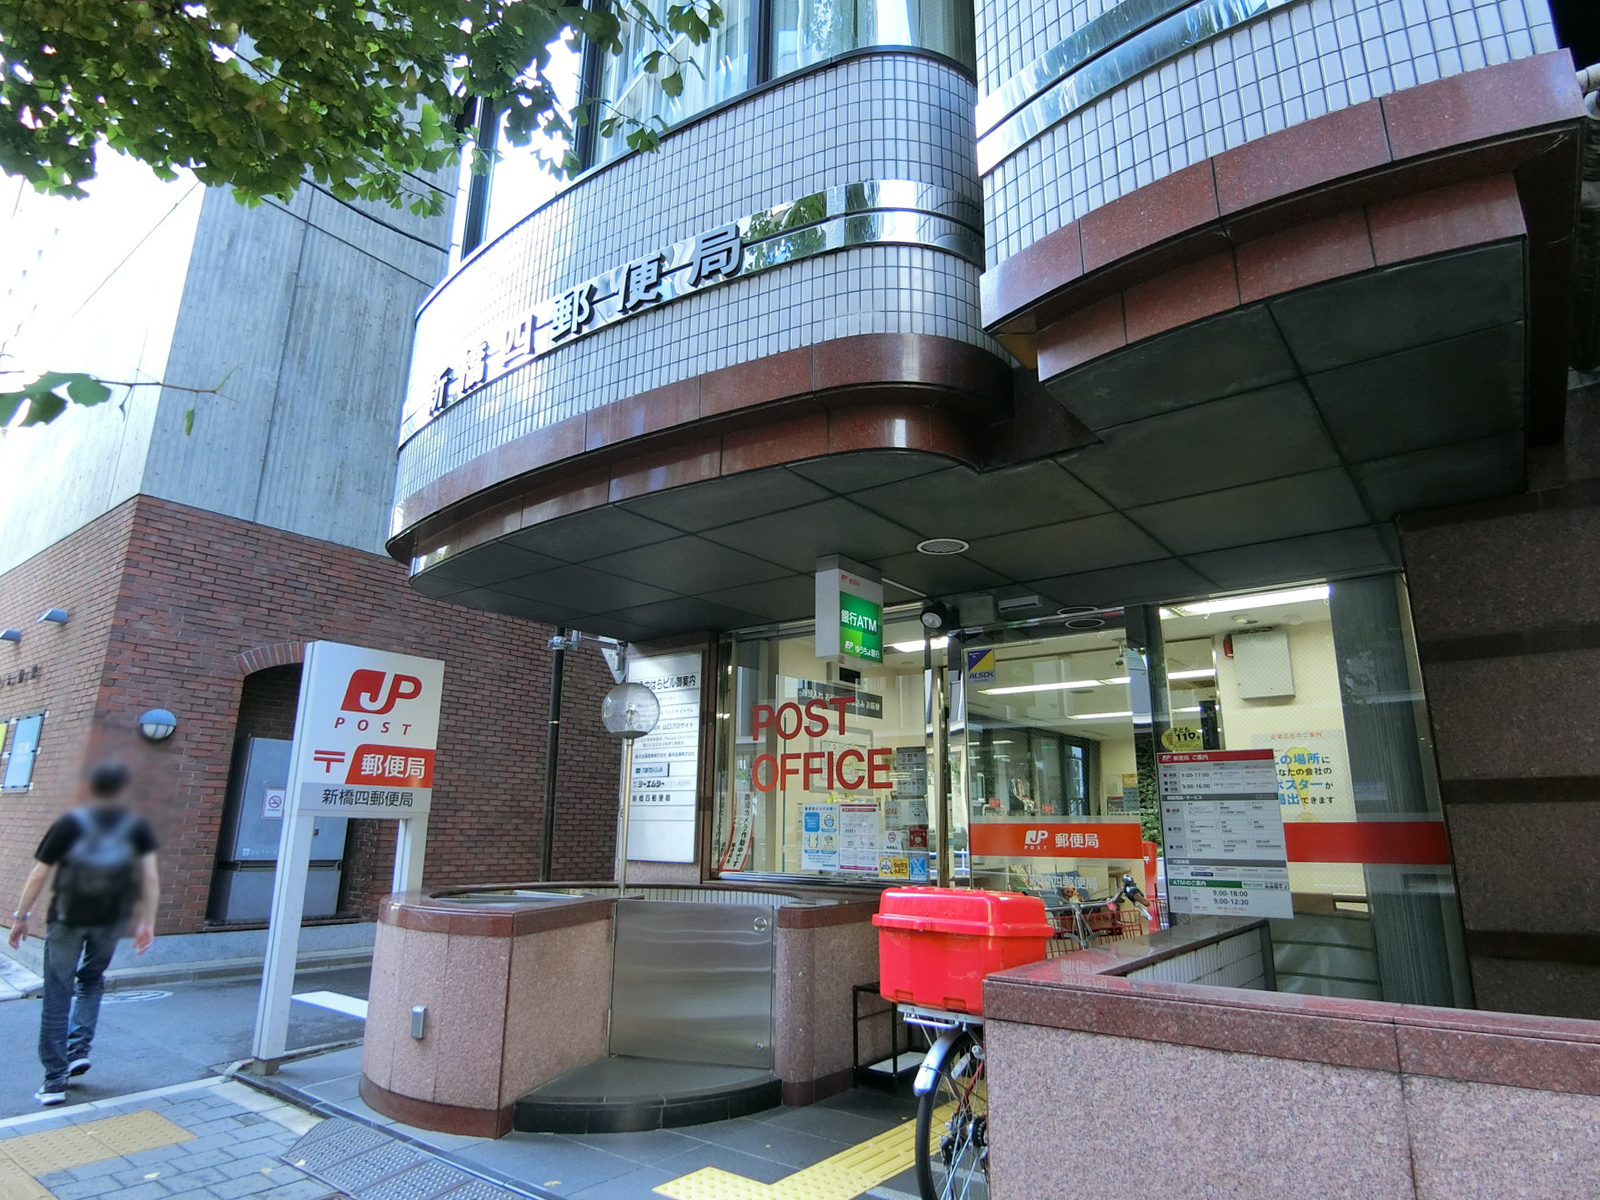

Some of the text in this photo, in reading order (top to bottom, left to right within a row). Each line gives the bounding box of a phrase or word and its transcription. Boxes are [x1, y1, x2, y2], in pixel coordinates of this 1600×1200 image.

[841, 609, 877, 633] 銀行ATM
[854, 645, 880, 659] ゆうちょ銀行
[969, 671, 994, 679] ALSOK
[340, 668, 423, 715] JP
[334, 717, 411, 736] POST
[752, 695, 856, 741] POST
[360, 753, 426, 779] 郵便局
[752, 748, 893, 792] OFFICE
[1276, 767, 1332, 776] なたの会社の
[322, 788, 414, 808] 新橋四郵便局
[885, 806, 899, 815] au
[1025, 830, 1049, 845] JP
[1055, 833, 1099, 848] 郵便局
